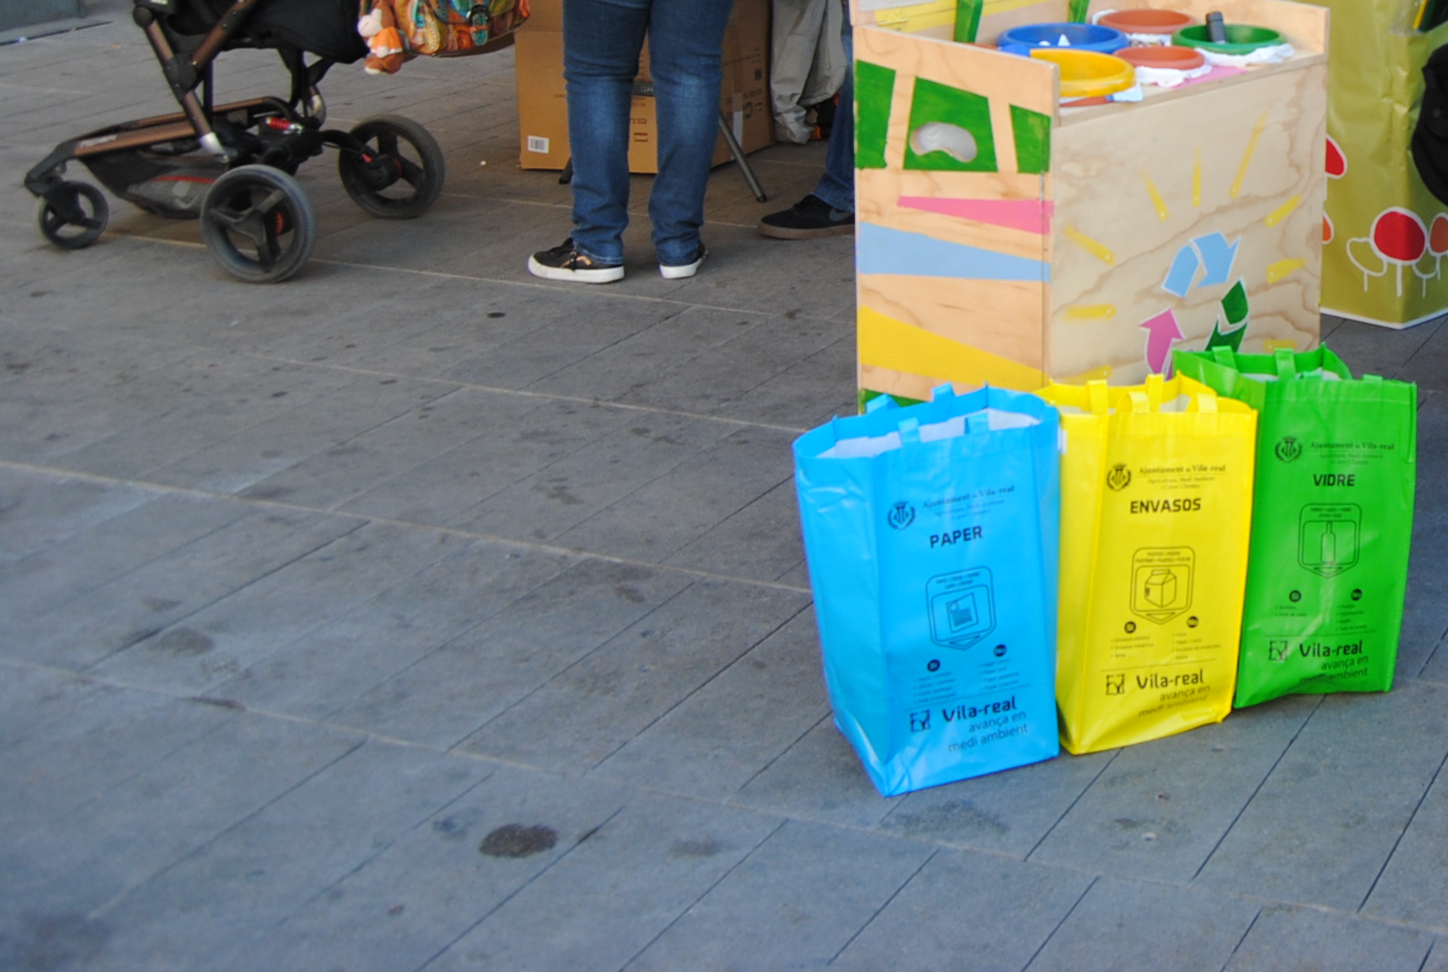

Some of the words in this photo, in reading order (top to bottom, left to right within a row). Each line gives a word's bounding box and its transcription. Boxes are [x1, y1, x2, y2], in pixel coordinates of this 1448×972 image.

[1313, 474, 1355, 487] VIDRE
[1130, 498, 1202, 514] ENVASOS
[930, 526, 983, 549] PAPER
[1300, 640, 1363, 658] Vila-real
[1321, 657, 1355, 671] avança
[1357, 655, 1369, 665] en
[1136, 668, 1204, 689] Vila-real
[1160, 688, 1195, 702] avança
[1197, 685, 1211, 694] en
[942, 695, 1017, 722] Vila-real
[969, 716, 1009, 733] avança
[1011, 710, 1027, 722] en
[948, 736, 978, 753] medi
[980, 724, 1028, 745] ambient
